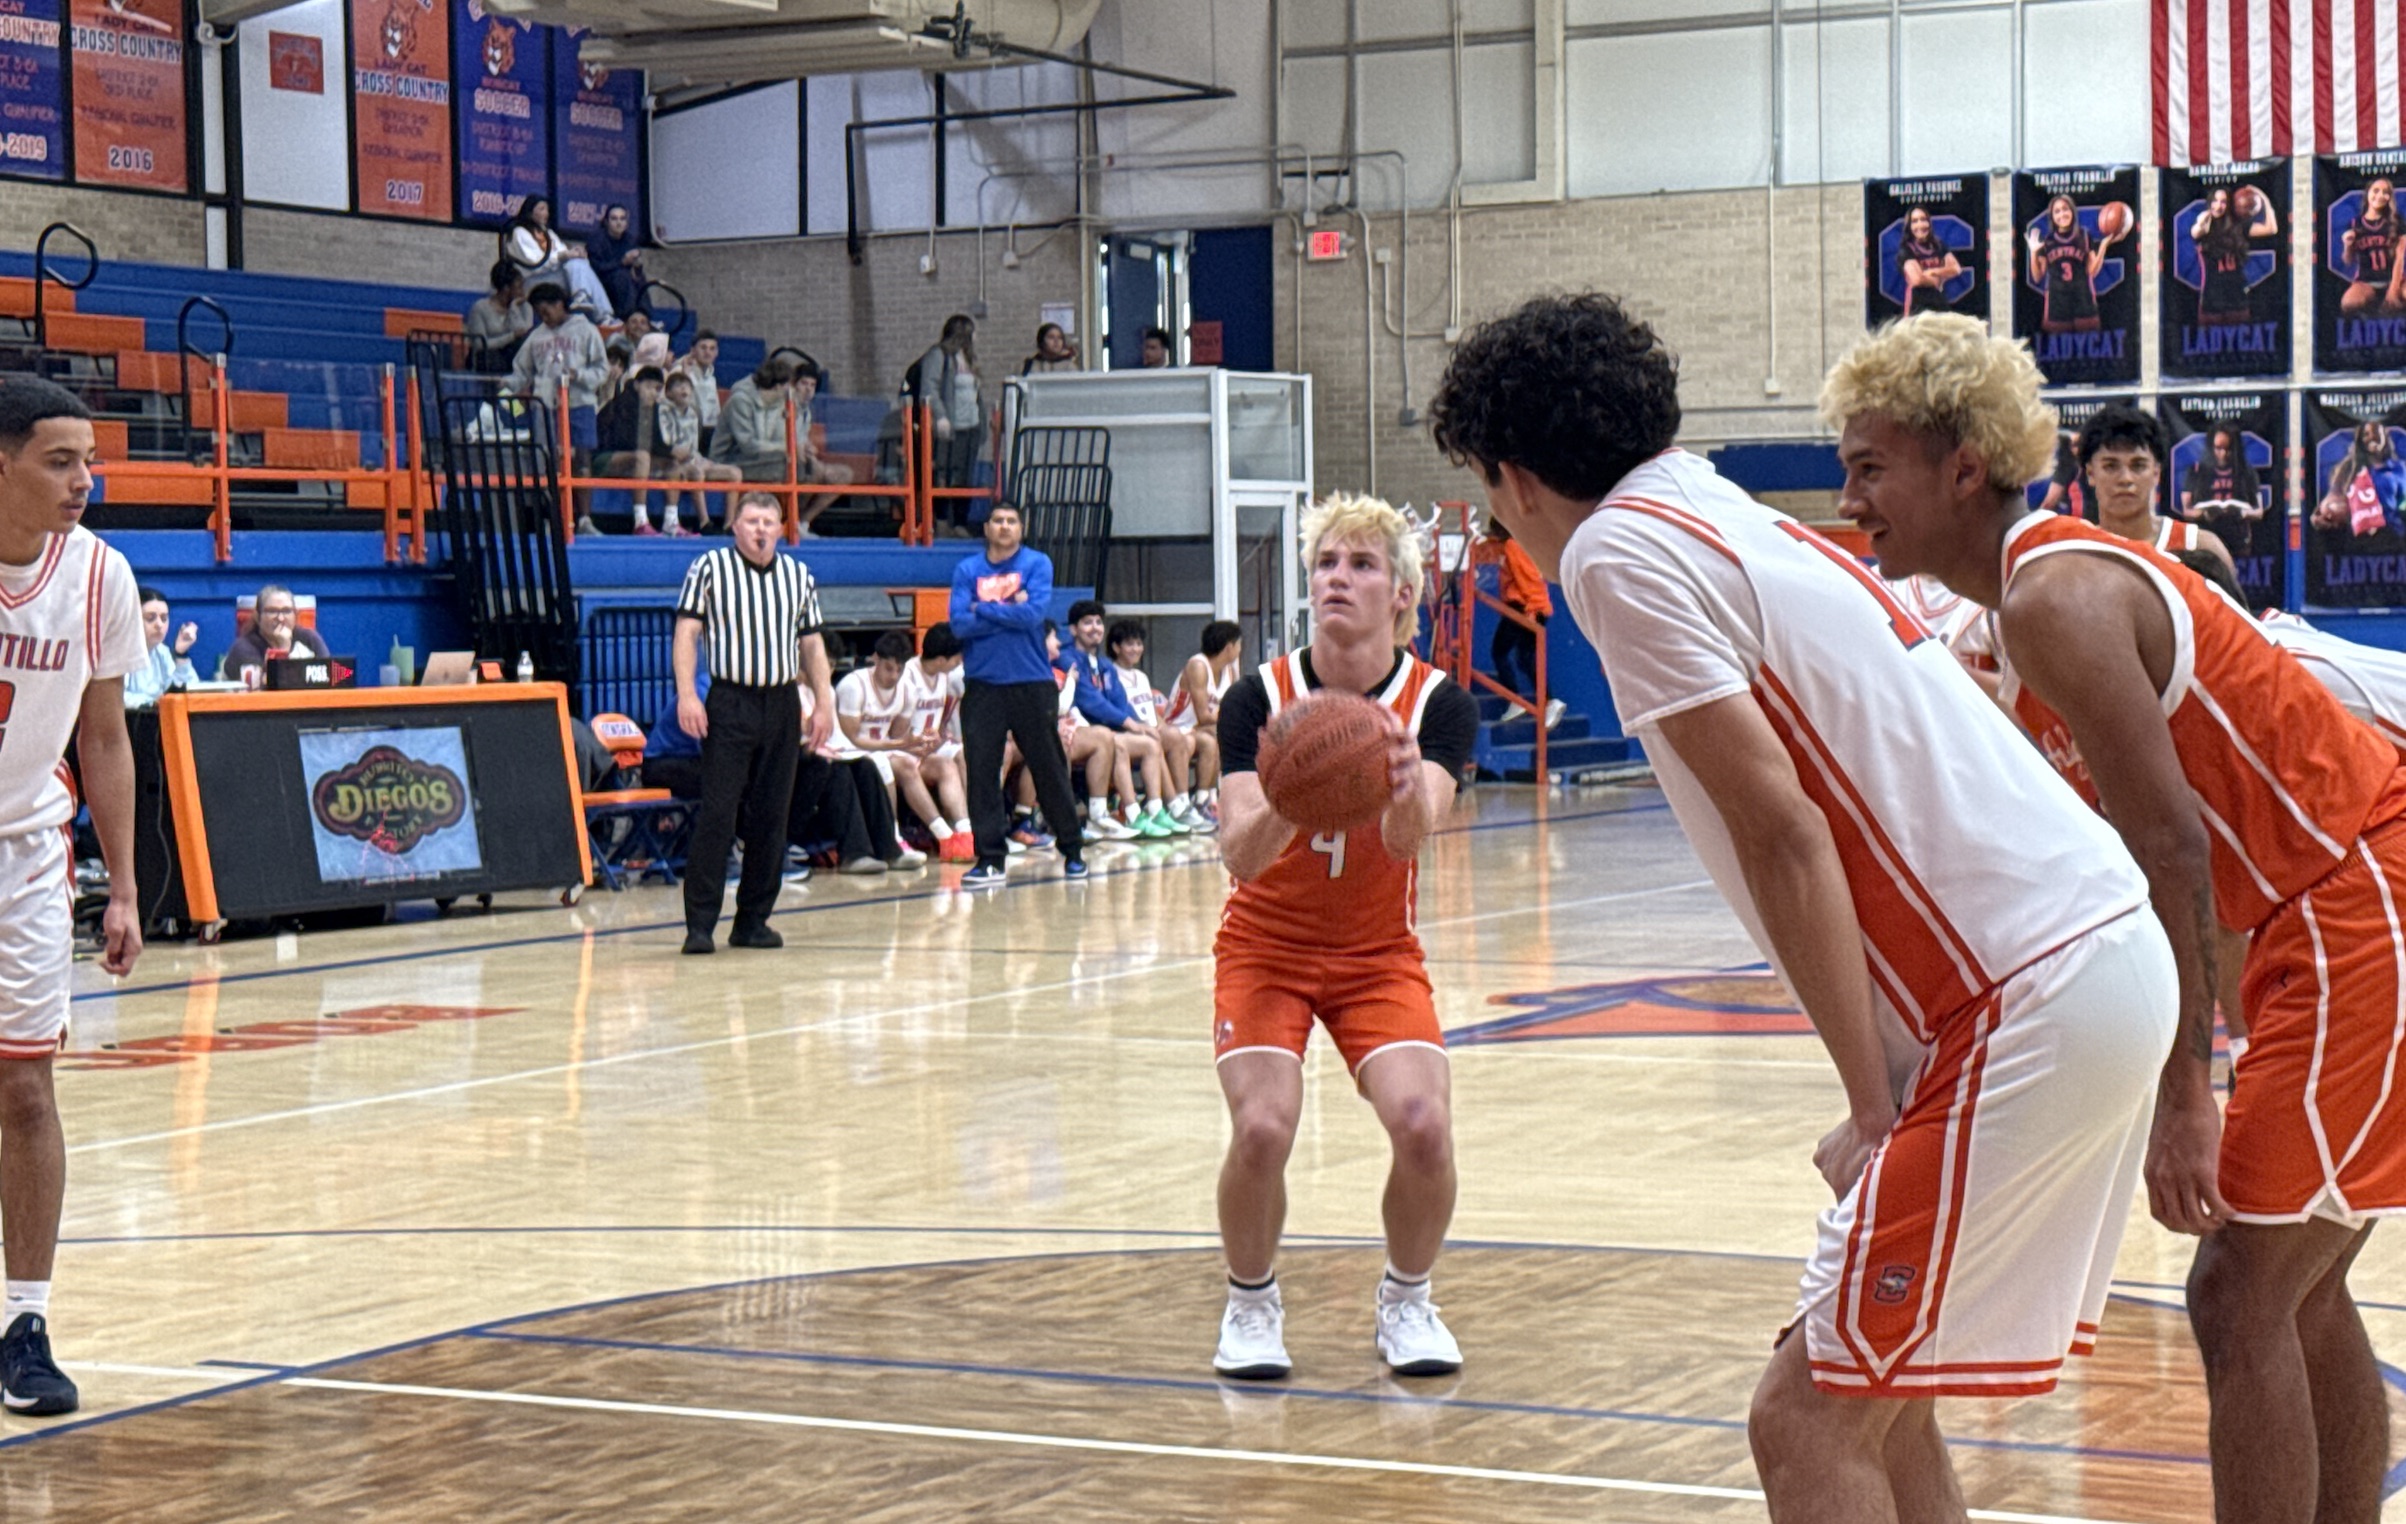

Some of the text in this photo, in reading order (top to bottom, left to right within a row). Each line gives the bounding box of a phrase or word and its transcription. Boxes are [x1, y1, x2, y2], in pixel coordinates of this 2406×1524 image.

[0, 15, 61, 48] OUNTRY
[72, 26, 183, 64] CROSS COUNTRY
[396, 75, 448, 104] COUNTRY
[474, 88, 530, 119] SOCCER
[570, 102, 623, 131] SOCCER
[0, 131, 48, 162] -2019
[109, 145, 153, 171] 2016
[387, 179, 423, 204] 2017
[2060, 262, 2073, 281] 3
[2034, 328, 2127, 361] LADYCAT
[2182, 321, 2278, 357] LADYCAT
[0, 631, 69, 671] TILLO
[328, 776, 453, 823] DIEGO'S
[1310, 831, 1348, 879] 4
